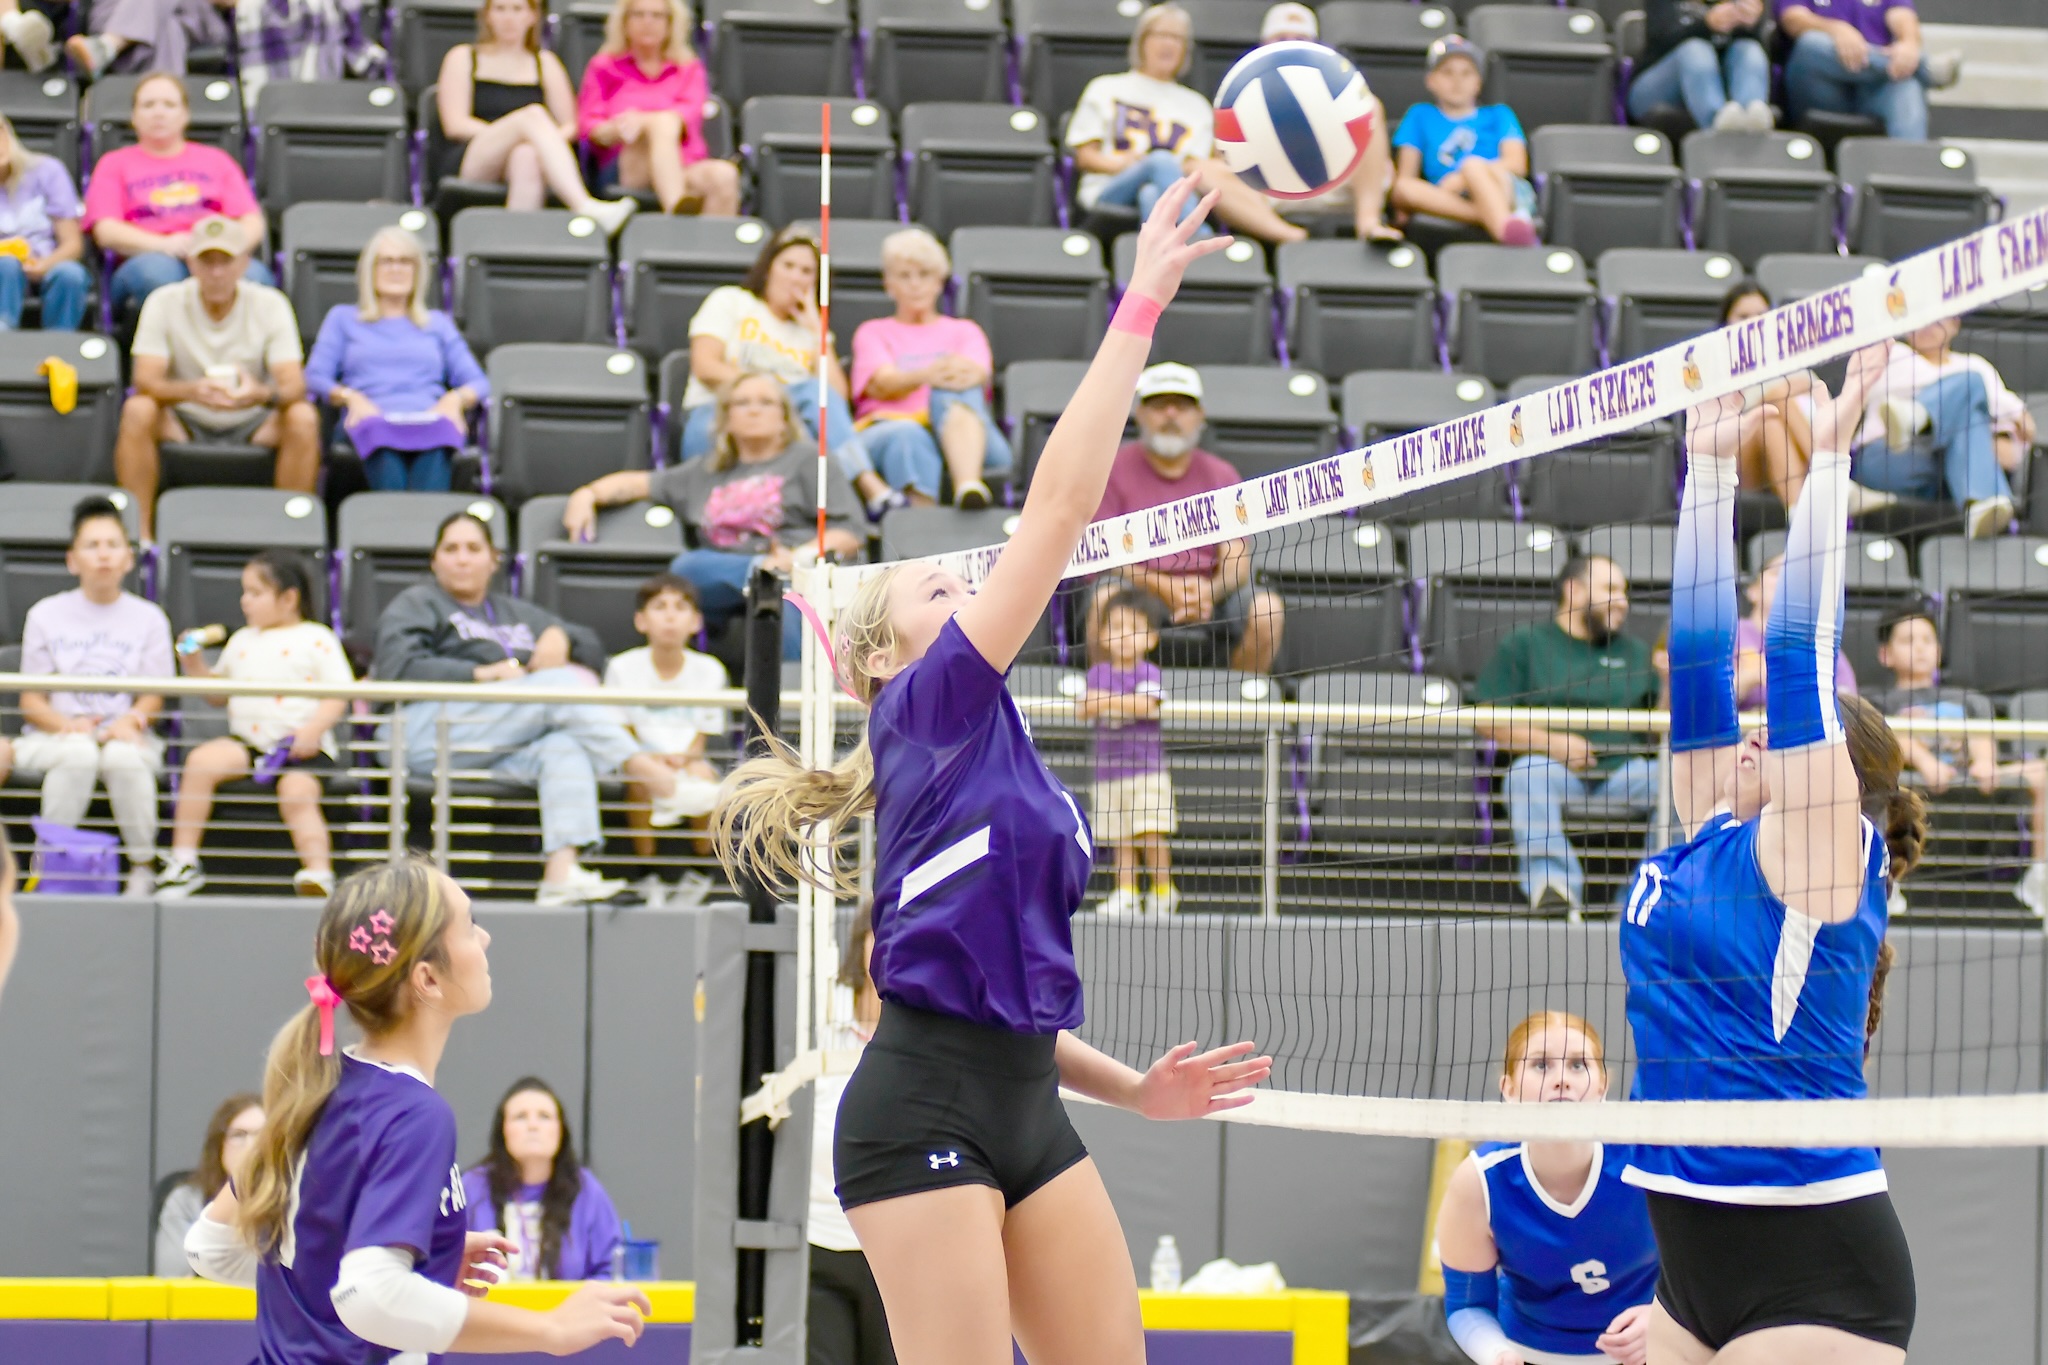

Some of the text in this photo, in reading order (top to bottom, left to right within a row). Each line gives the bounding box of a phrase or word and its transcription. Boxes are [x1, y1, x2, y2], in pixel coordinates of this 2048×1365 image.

[1939, 236, 1984, 300] LADY
[1726, 287, 1854, 376] LADY FARMERS
[1548, 360, 1657, 436] LADY FARMERS
[1393, 414, 1487, 481] LADY FARMERS
[1261, 458, 1344, 518] LADY FARMERS
[1146, 495, 1221, 547] LADY FARMERS
